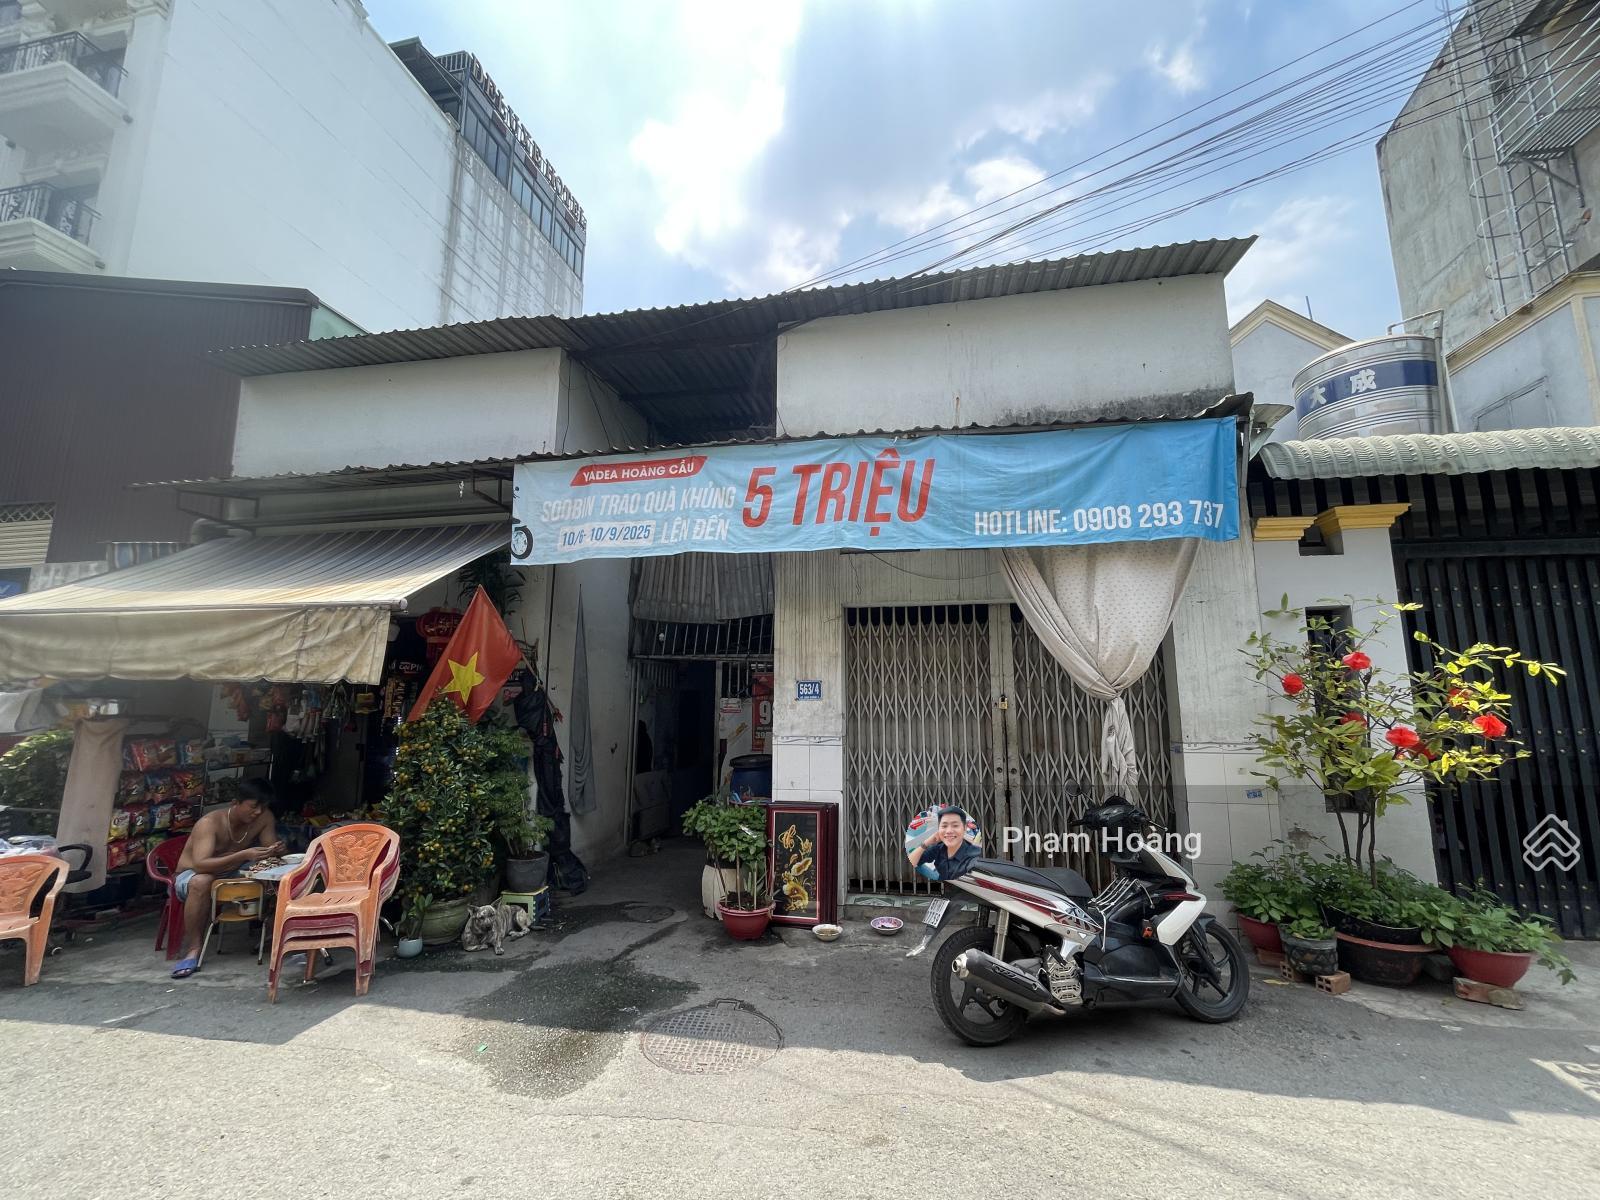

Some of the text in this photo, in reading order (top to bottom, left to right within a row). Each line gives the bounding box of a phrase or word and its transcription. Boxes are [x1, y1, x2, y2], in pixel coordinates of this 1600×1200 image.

[545, 159, 586, 226] HOTEL
[582, 459, 695, 483] YADEA HOÀNG CẦU
[598, 493, 640, 516] TRAO
[642, 487, 677, 514] QUÀ
[680, 481, 737, 511] KHỦNG
[742, 447, 936, 537] 5 TRIỆU
[590, 525, 652, 542] 10/9/2025
[661, 521, 690, 544] LÊN
[692, 512, 731, 542] ĐẾN
[974, 499, 1224, 536] HOTLINE: 0908 293 737
[799, 683, 820, 695] 563/4
